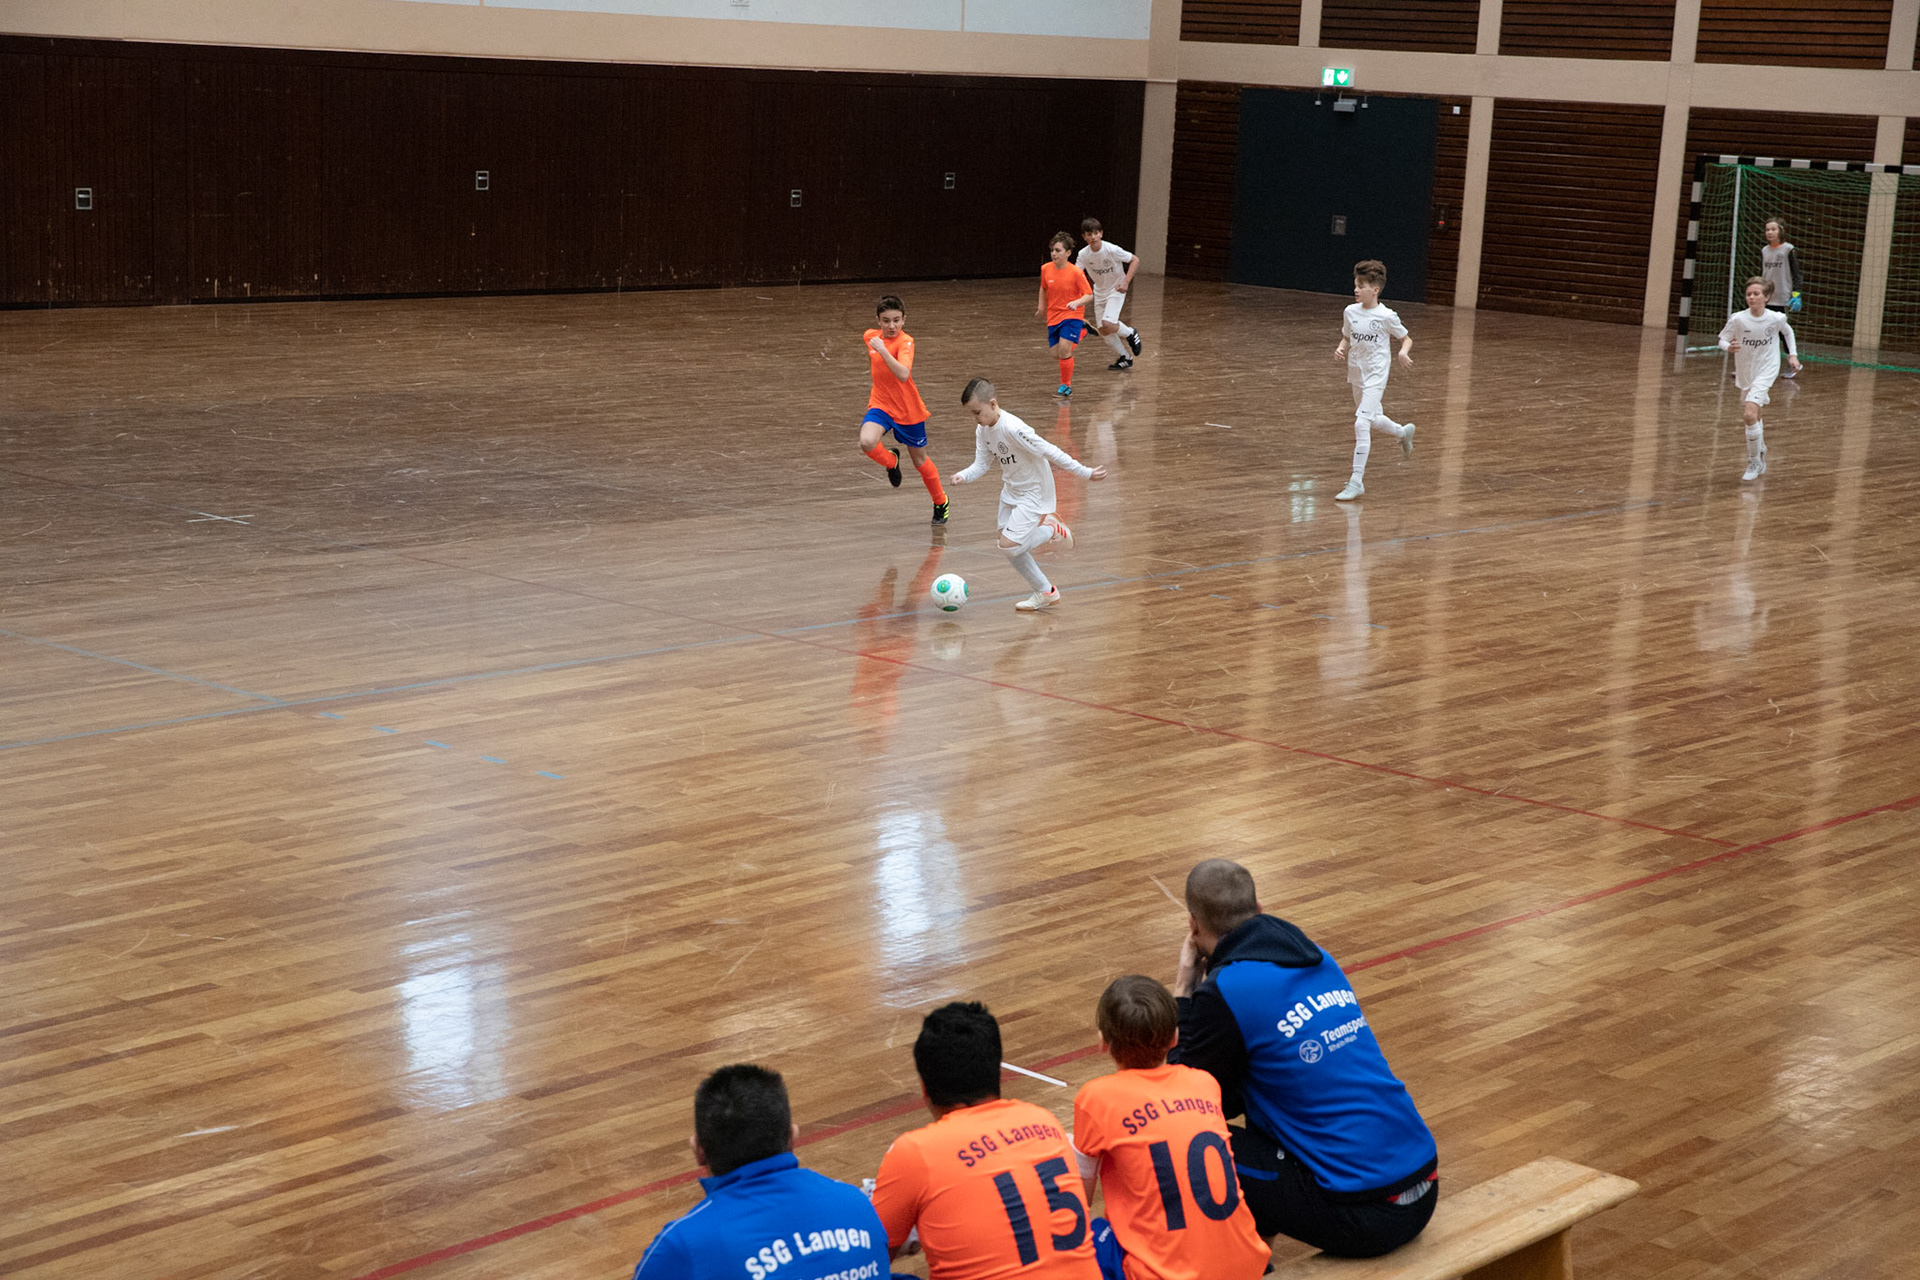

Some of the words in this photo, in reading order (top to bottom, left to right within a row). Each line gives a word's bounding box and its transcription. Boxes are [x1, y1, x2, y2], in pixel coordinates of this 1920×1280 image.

[1351, 331, 1379, 343] aport
[1277, 1002, 1314, 1038] SSG
[1306, 989, 1357, 1012] Langen
[1122, 1102, 1160, 1135] SSG
[958, 1134, 998, 1168] SSG
[997, 1123, 1062, 1146] Langen
[1148, 1130, 1240, 1231] 10
[993, 1156, 1087, 1266] 15
[745, 1239, 793, 1280] SSG
[793, 1228, 871, 1256] Langen
